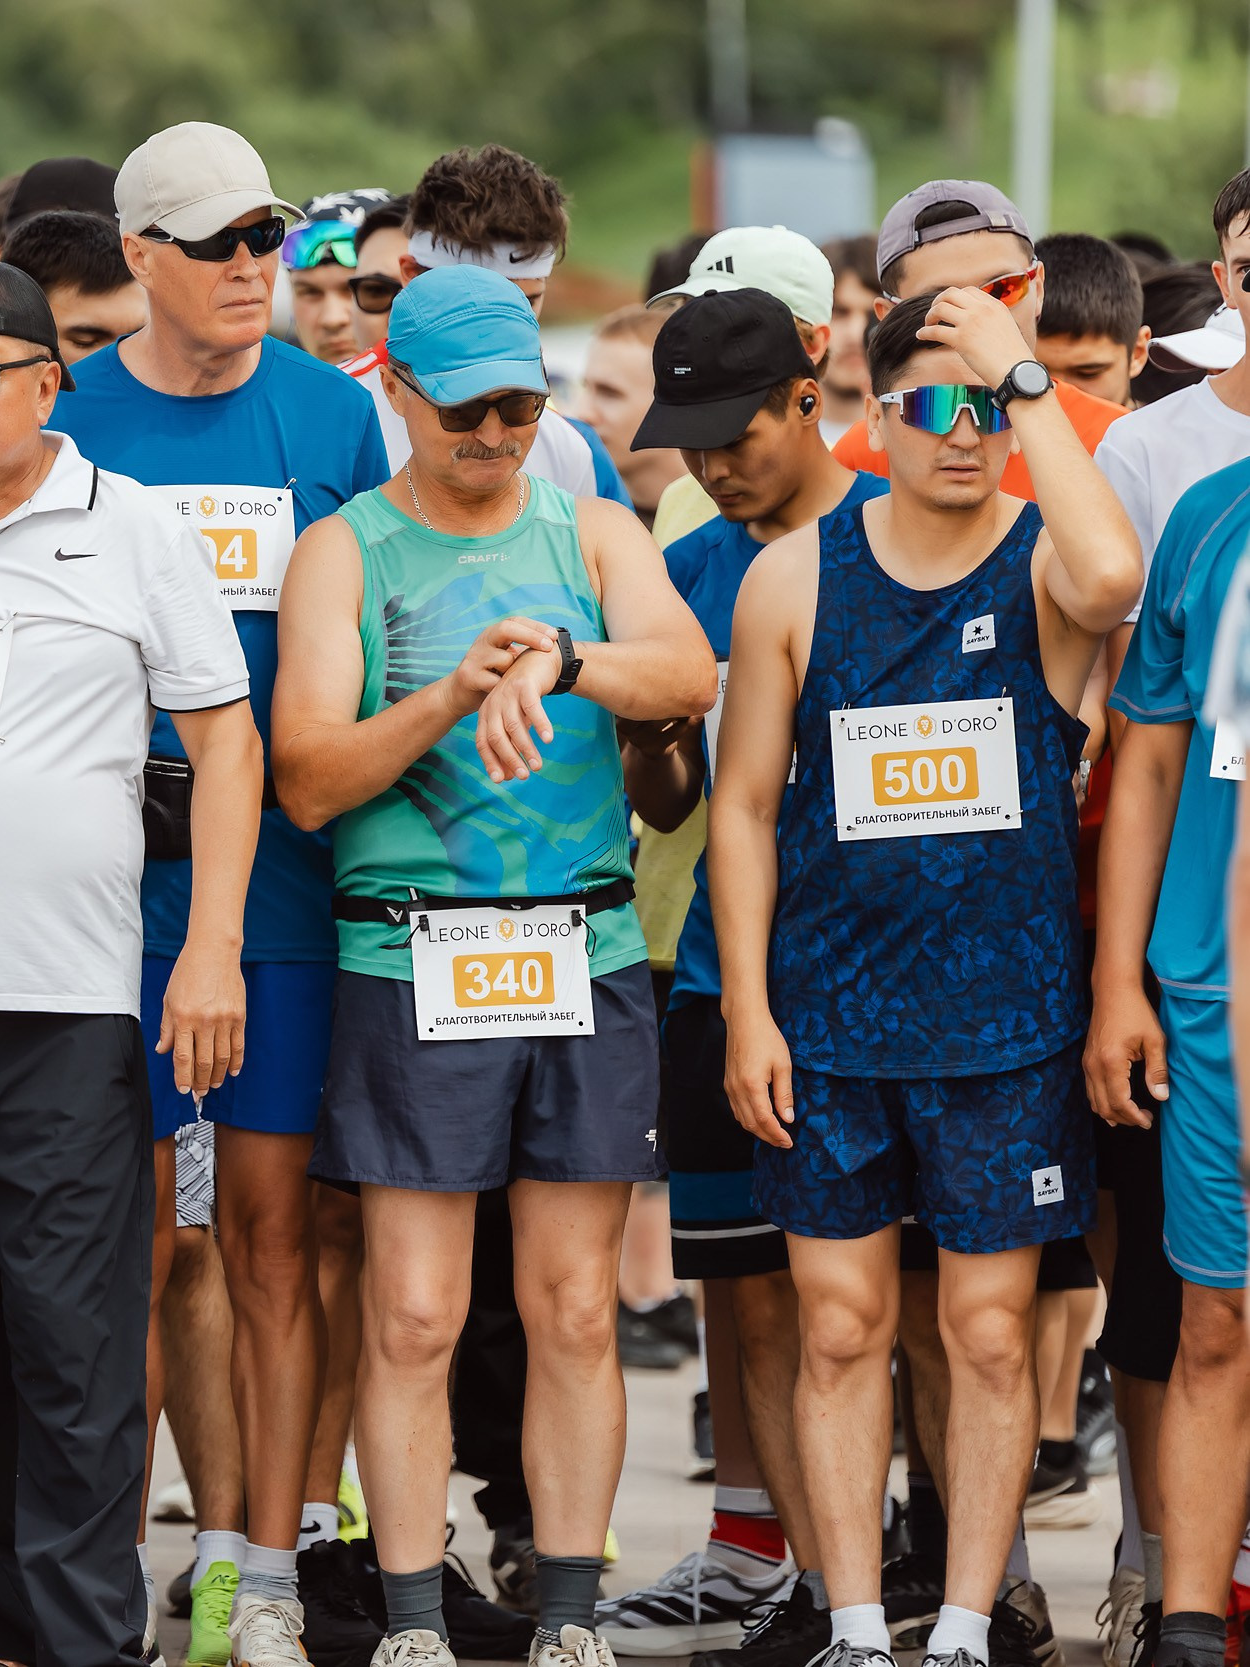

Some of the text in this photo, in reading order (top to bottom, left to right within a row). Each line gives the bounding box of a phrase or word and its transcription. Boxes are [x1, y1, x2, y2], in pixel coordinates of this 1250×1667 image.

[457, 552, 499, 565] CRAFT
[249, 587, 278, 597] ЗАБЕГ
[966, 635, 990, 645] SAYSKY
[847, 716, 998, 741] LEONE D'ORO
[884, 754, 967, 799] 500
[855, 805, 1002, 825] БЛАГОТВОРИТЕЛЬНЫЙ ЗАБЕГ
[428, 922, 571, 943] LEONE D'ORO
[464, 958, 544, 1001] 340
[435, 1010, 576, 1026] БЛАГОТВОРИТЕЛЬНЫЙ ЗАБЕГ
[1037, 1187, 1059, 1197] SAYSKY
